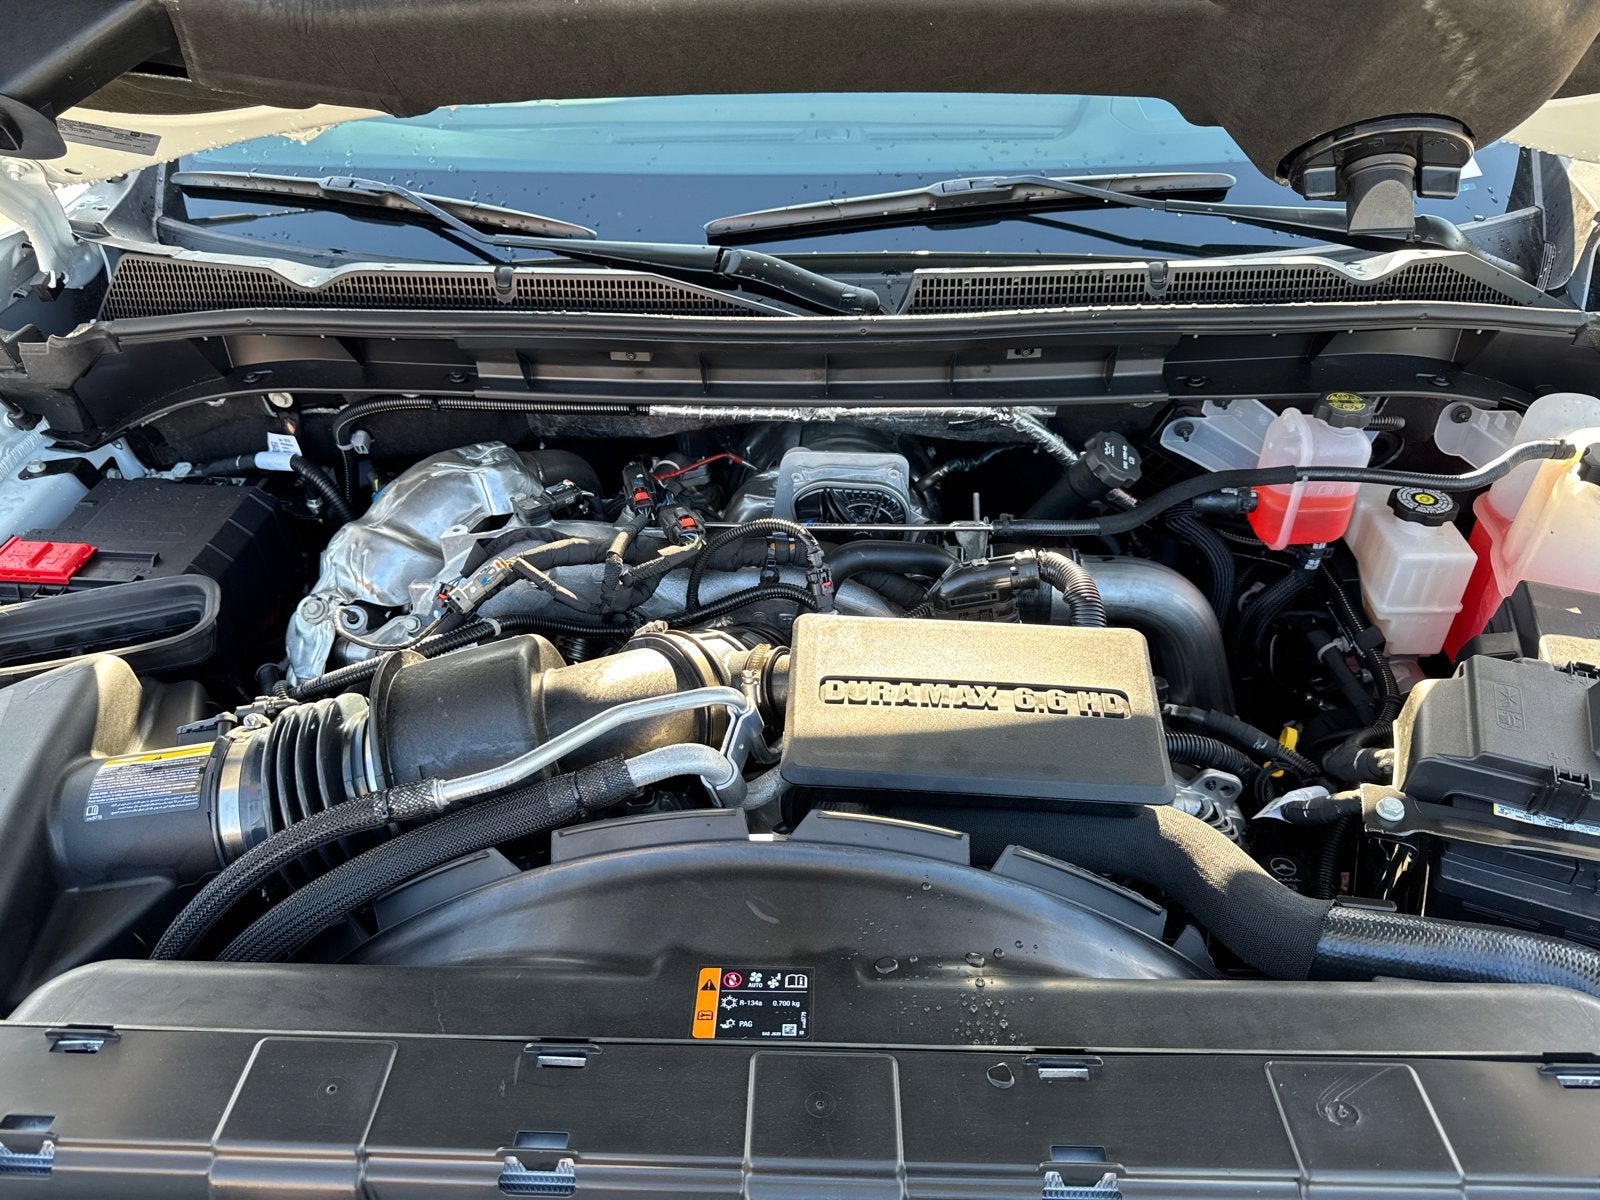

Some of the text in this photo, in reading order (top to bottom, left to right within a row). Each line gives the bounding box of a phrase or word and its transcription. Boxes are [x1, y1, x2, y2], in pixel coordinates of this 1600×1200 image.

[823, 679, 1127, 719] DURAMAX 6.6 HD
